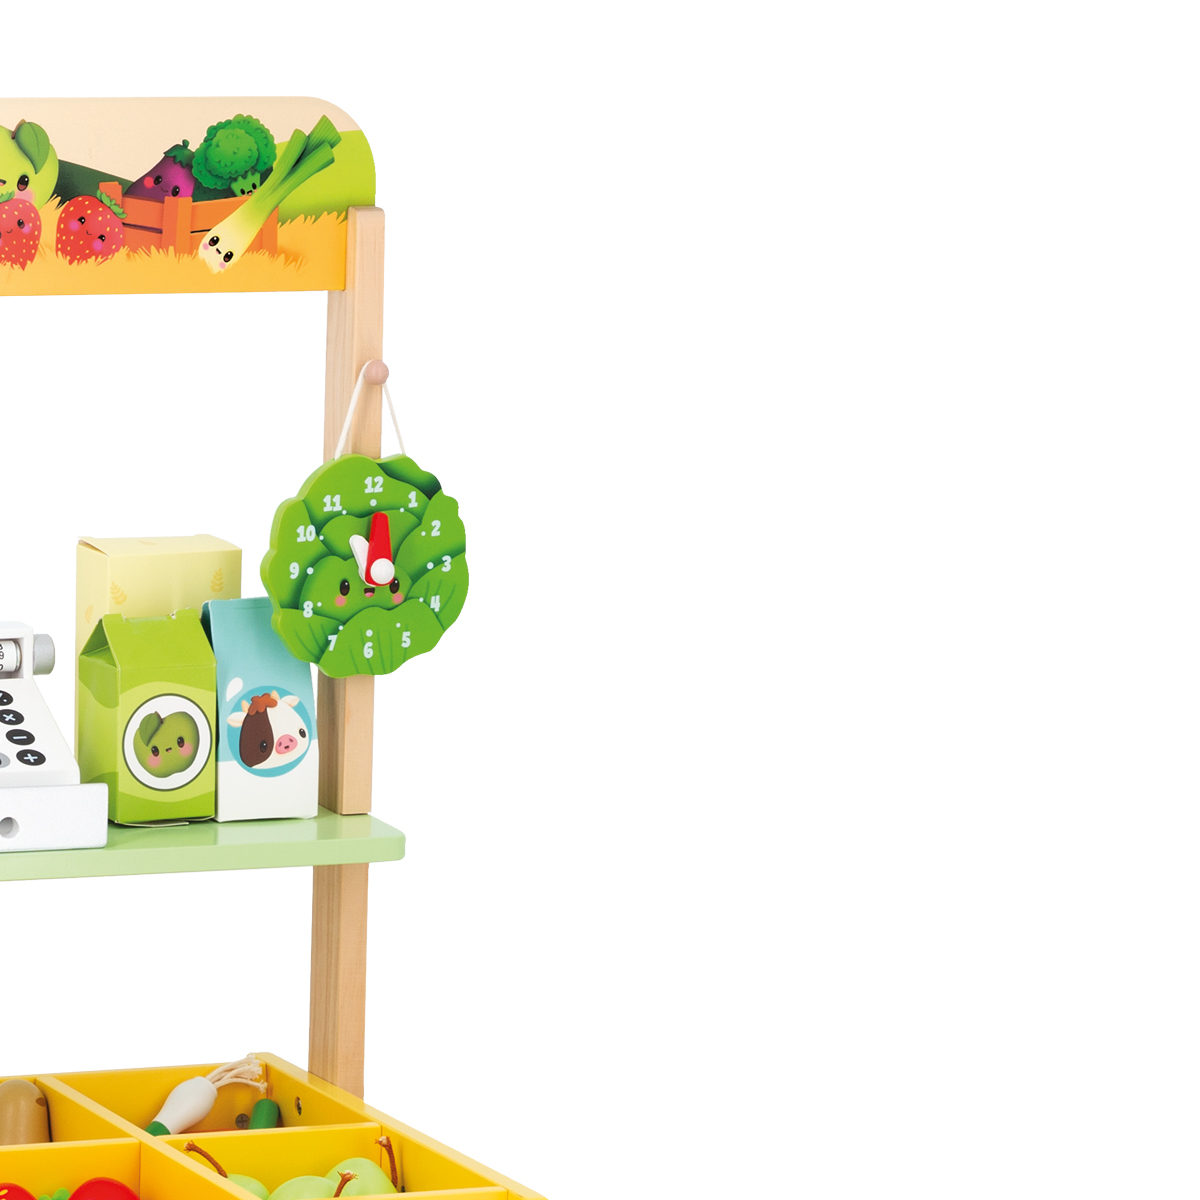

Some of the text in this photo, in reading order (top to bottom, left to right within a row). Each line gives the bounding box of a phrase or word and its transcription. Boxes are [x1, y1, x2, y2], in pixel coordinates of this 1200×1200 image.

[364, 476, 384, 493] 12
[323, 494, 342, 512] 11
[408, 491, 418, 508] 1
[296, 525, 316, 542] 10
[431, 520, 441, 537] 2
[289, 562, 300, 579] 9
[441, 555, 452, 572] 3
[303, 600, 313, 618] 8
[430, 595, 441, 612] 4
[327, 634, 337, 651] 7
[401, 631, 411, 648] 5
[363, 642, 373, 659] 6
